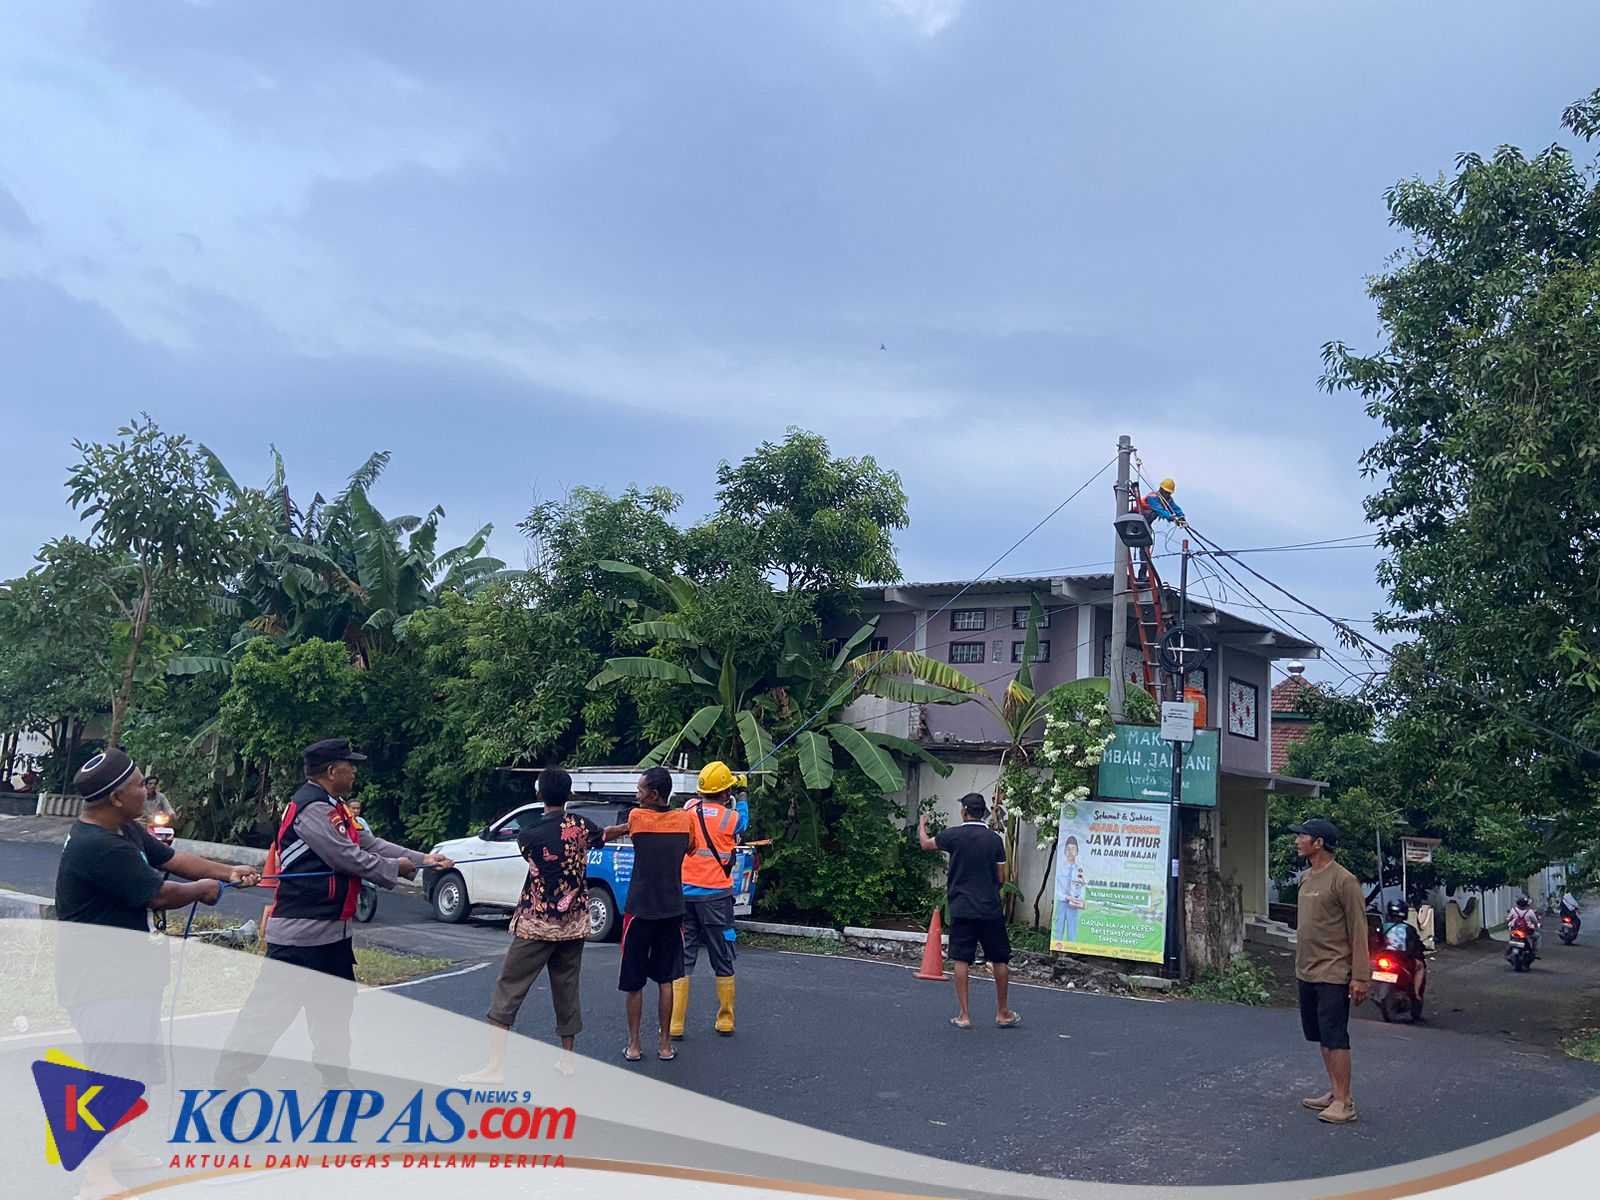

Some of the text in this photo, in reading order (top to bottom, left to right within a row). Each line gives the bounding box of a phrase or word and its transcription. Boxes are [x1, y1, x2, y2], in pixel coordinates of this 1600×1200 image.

[1128, 731, 1185, 747] MAK
[1103, 750, 1211, 771] MBAH JAANI
[1094, 810, 1119, 821] Selamat
[1086, 835, 1161, 848] JAWA TIMUR
[586, 850, 603, 865] 123
[1090, 848, 1158, 860] MA DARUN NAJAH
